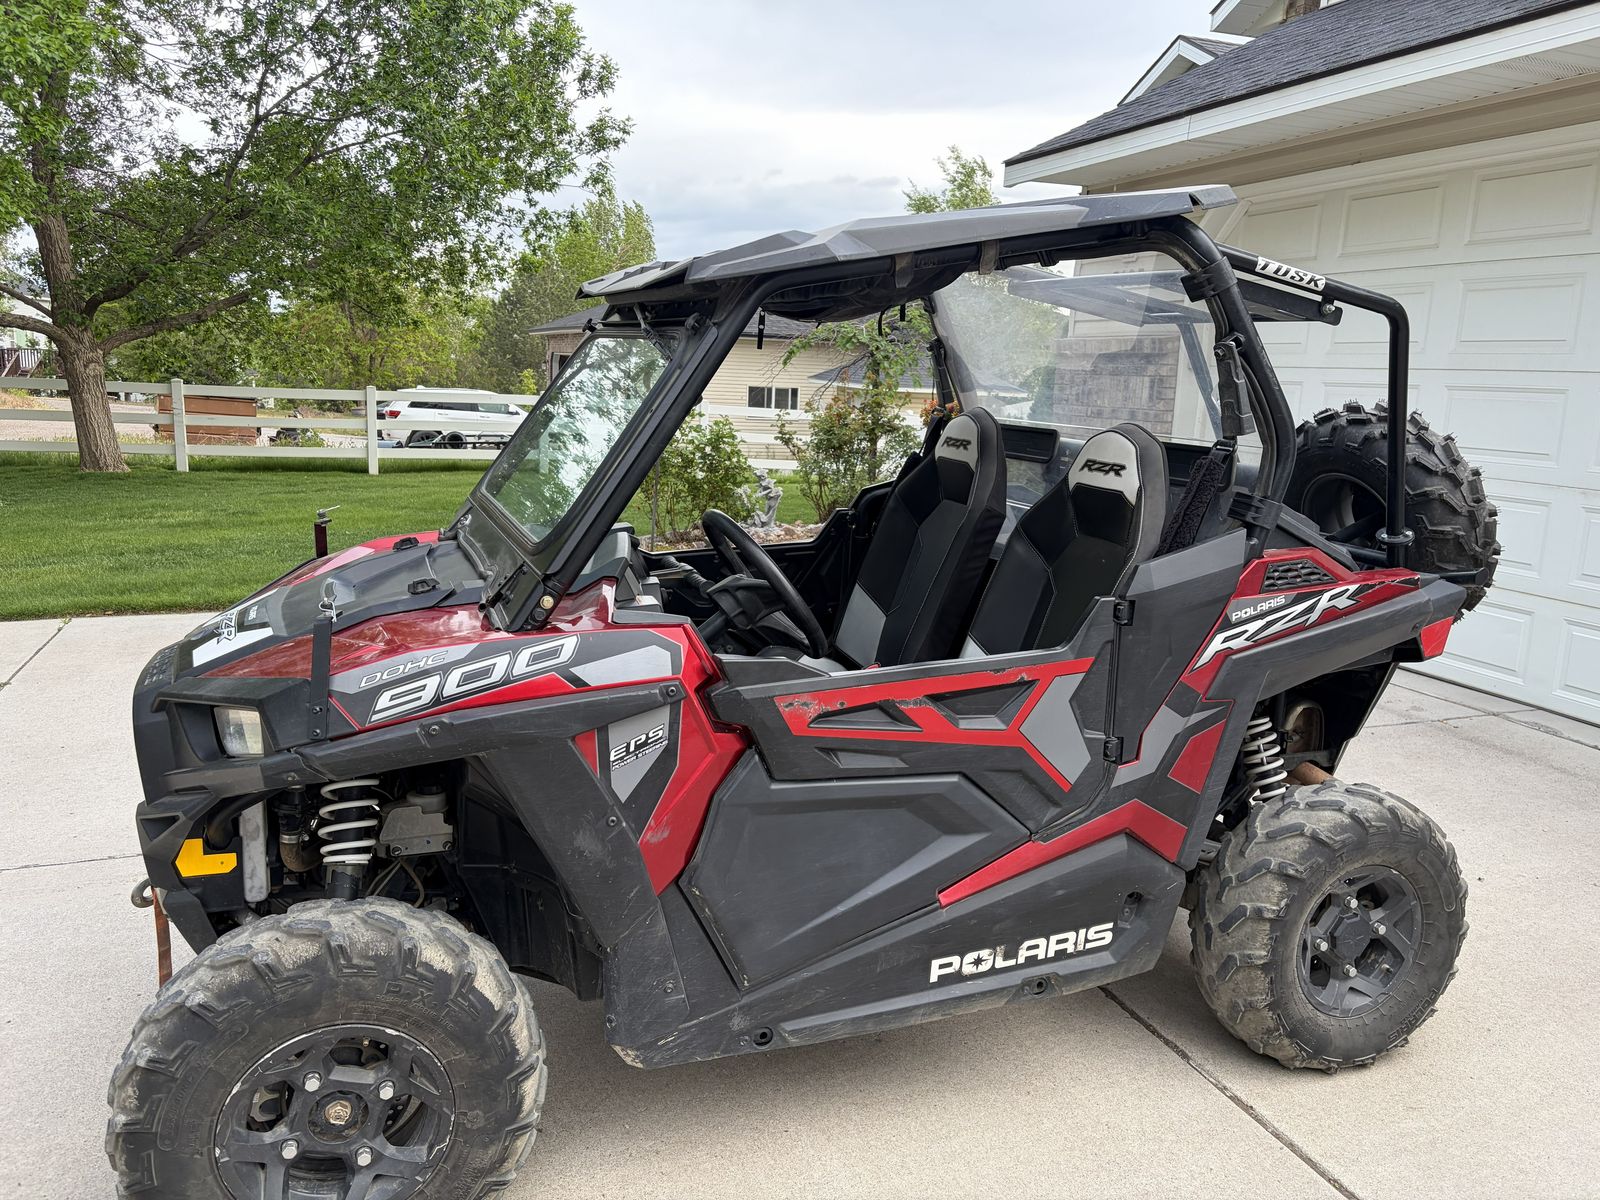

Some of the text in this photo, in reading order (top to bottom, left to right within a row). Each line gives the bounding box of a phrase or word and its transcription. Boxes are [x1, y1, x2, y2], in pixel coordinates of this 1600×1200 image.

[1259, 261, 1323, 288] TUSK
[941, 436, 971, 451] RZR
[1079, 458, 1127, 477] RZR
[1231, 595, 1286, 622] POLARIS
[1191, 584, 1359, 672] RZR
[359, 650, 448, 688] DOHC
[369, 634, 580, 722] 900
[610, 724, 664, 761] EPS
[929, 922, 1114, 984] POLARIS
